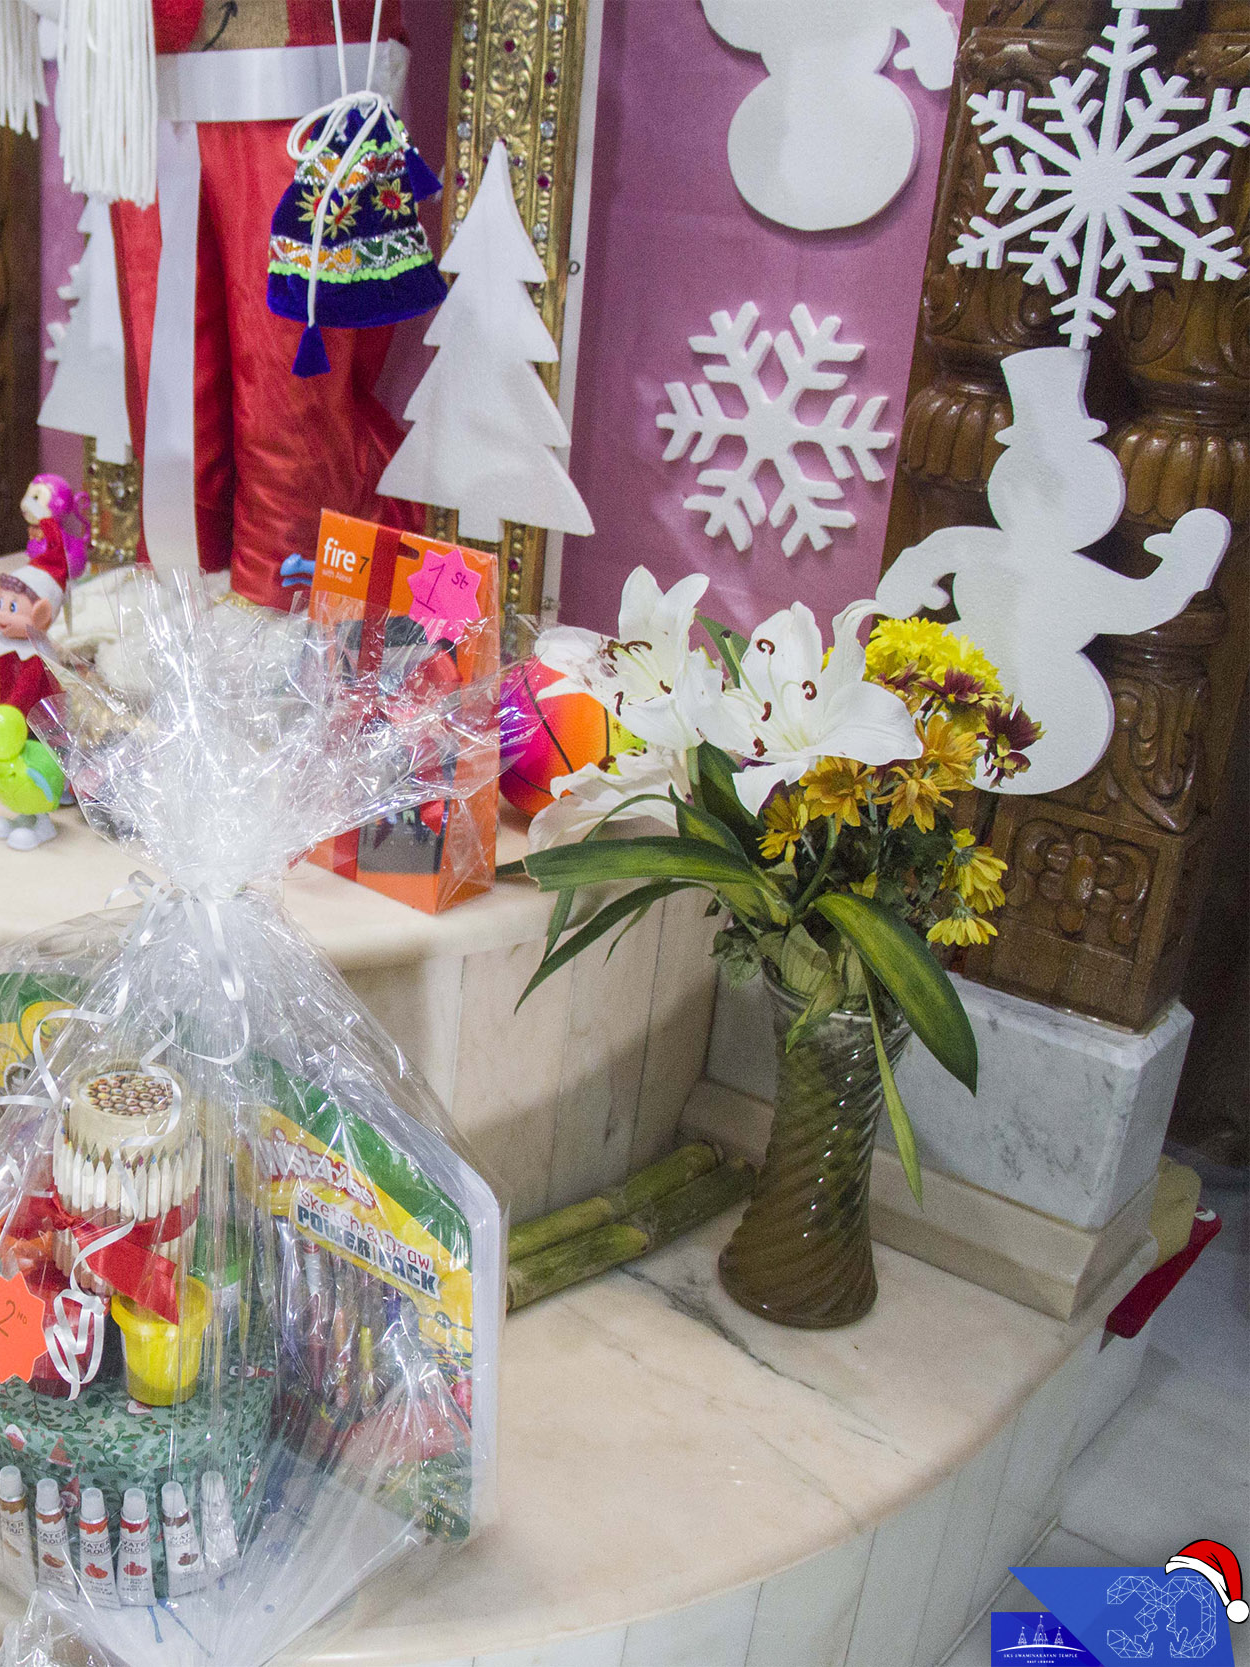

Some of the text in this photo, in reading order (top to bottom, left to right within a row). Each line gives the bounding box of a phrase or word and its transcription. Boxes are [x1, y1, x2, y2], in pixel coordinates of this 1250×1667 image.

[323, 537, 371, 574] fire 7
[297, 1204, 437, 1295] POWER PACK
[300, 1191, 360, 1232] Sketch
[384, 1233, 430, 1271] Draw
